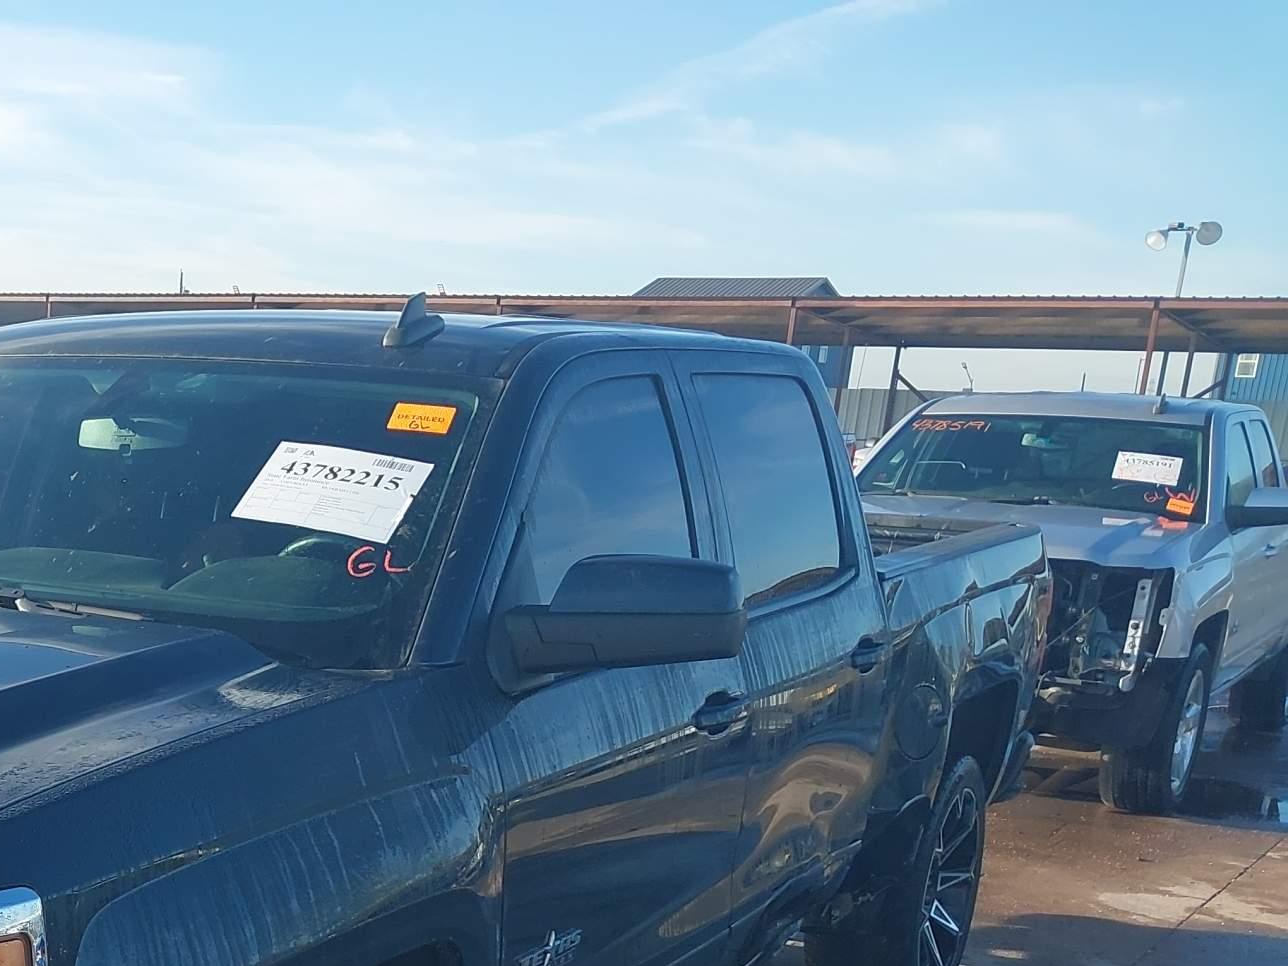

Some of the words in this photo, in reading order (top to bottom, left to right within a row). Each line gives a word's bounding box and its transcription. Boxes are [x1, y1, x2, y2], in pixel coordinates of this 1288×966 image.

[397, 413, 446, 423] DETAILED
[280, 459, 405, 491] 43782215
[347, 545, 410, 578] GL
